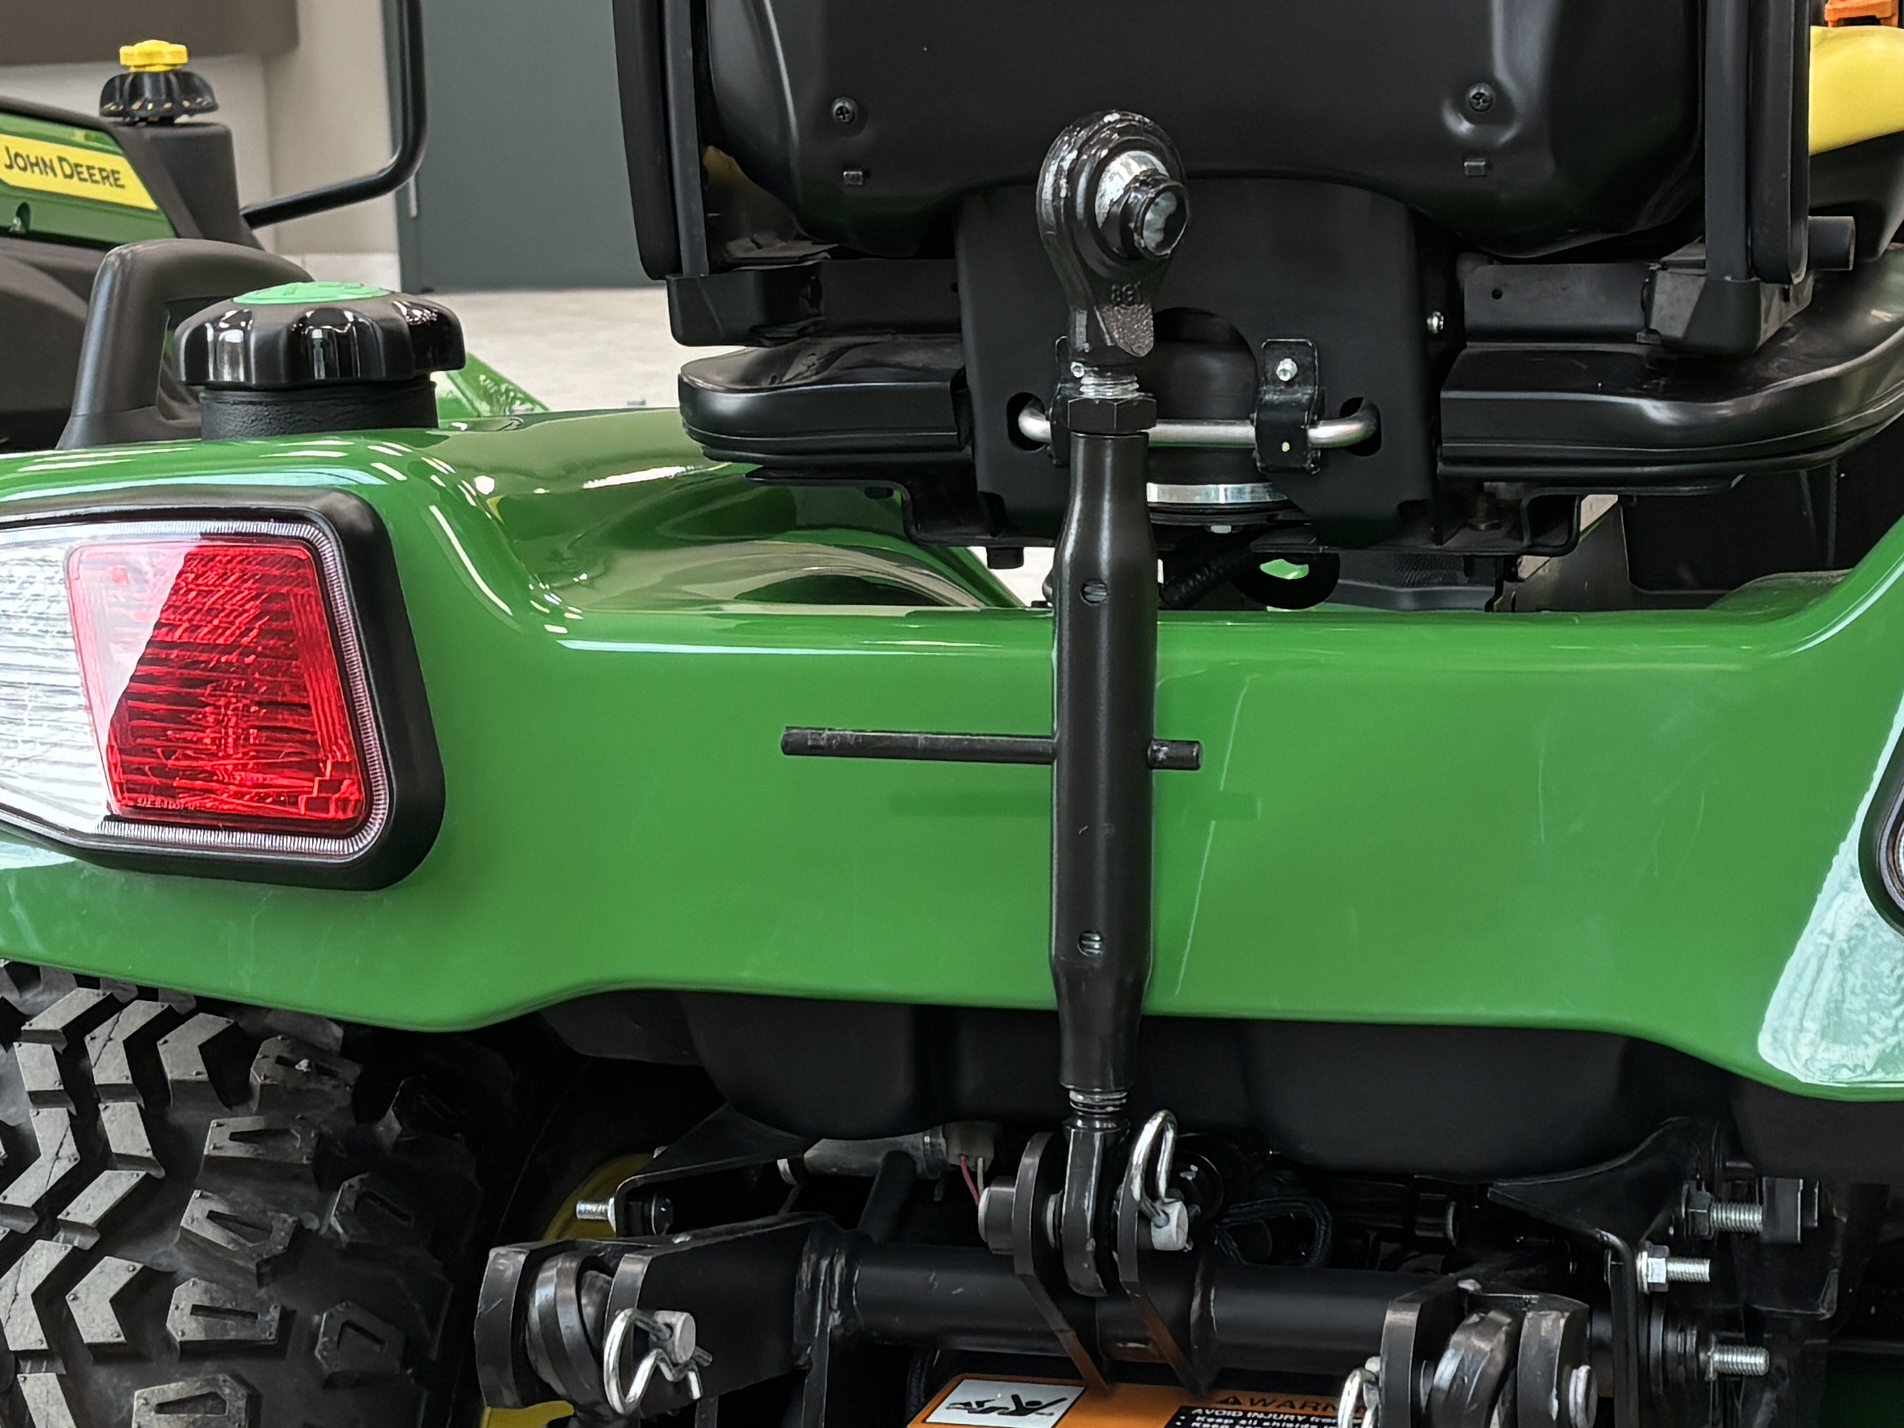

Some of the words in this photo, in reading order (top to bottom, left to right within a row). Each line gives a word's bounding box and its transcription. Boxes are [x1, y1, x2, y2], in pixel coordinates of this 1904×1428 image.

[4, 145, 58, 178] JOHN
[56, 155, 126, 189] DEERE
[1191, 1408, 1244, 1418] AVOID
[1247, 1411, 1307, 1422] INJURY
[1196, 1415, 1235, 1425] Keep
